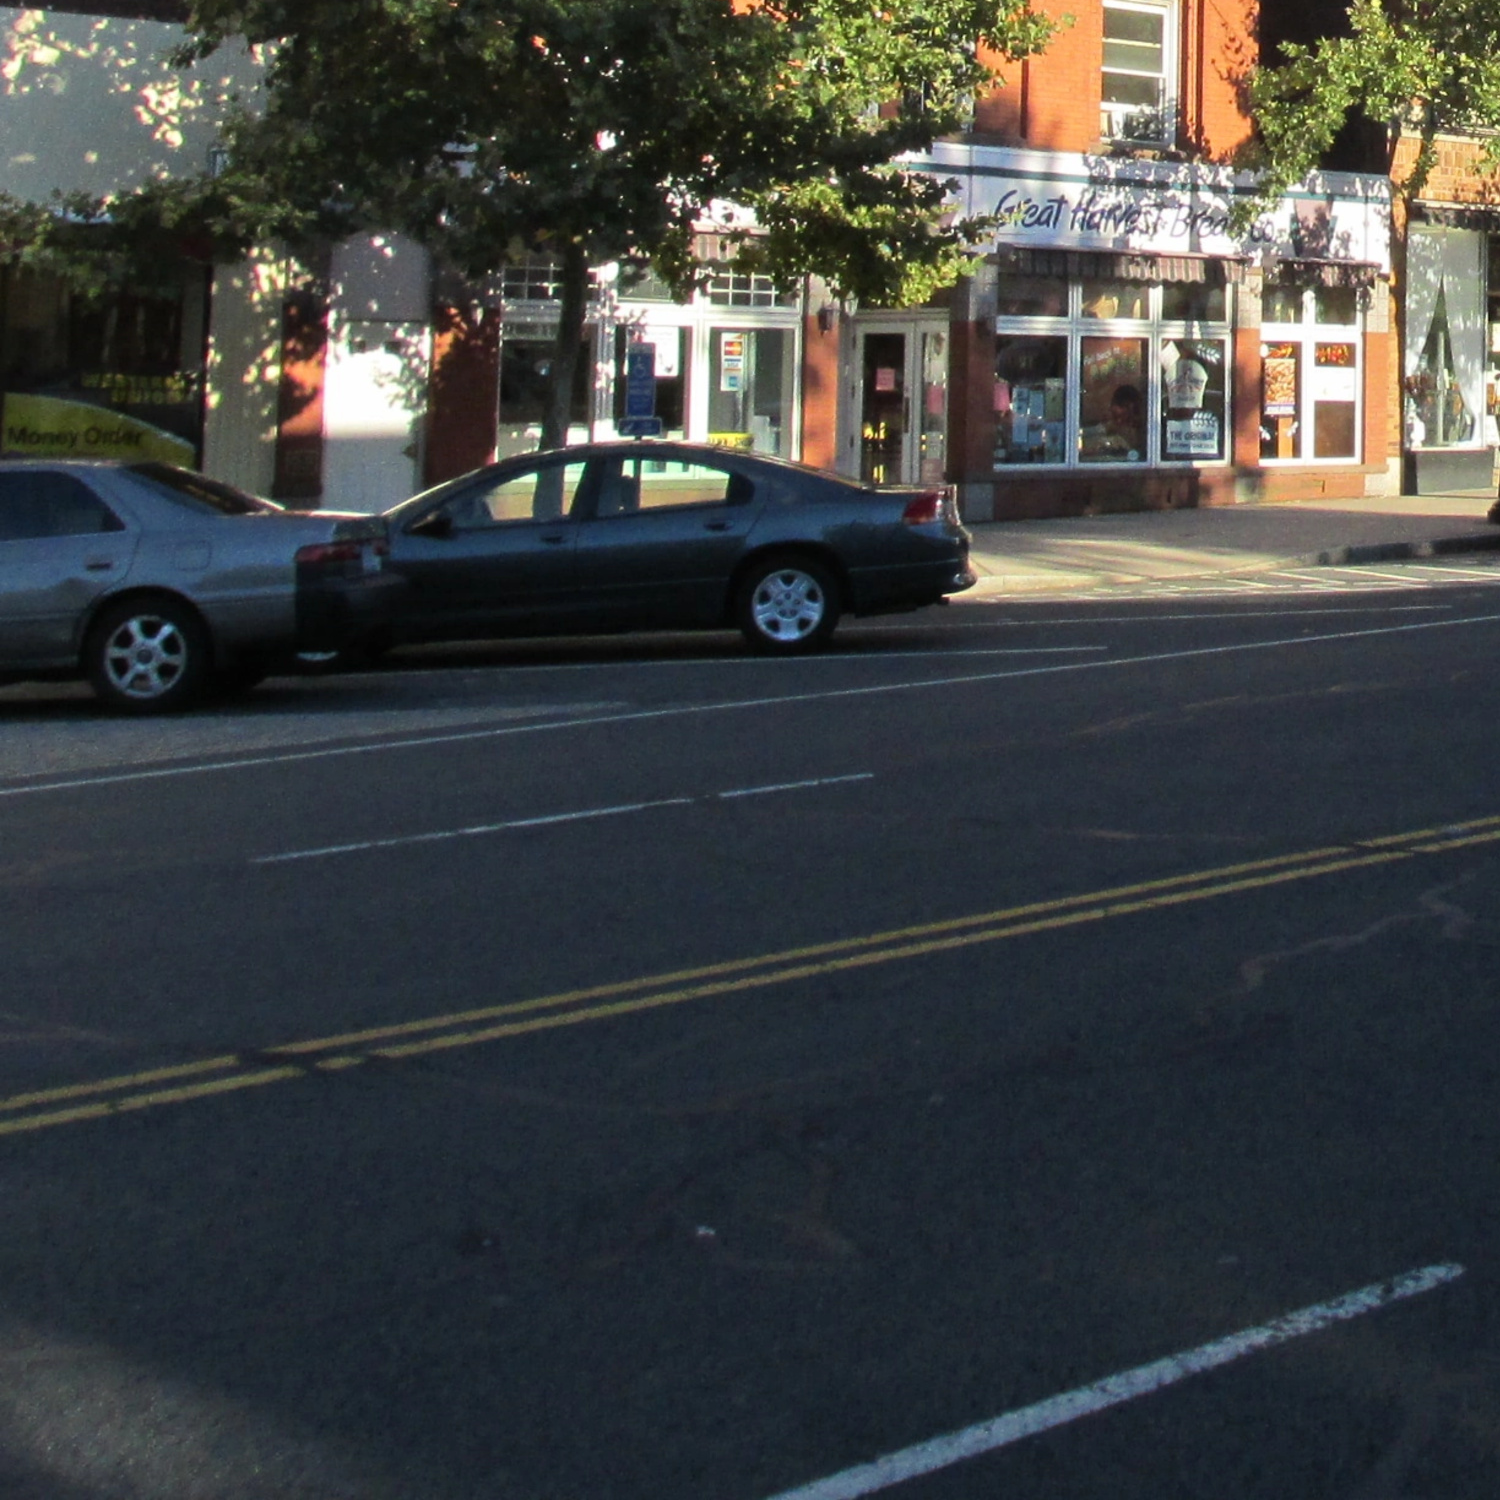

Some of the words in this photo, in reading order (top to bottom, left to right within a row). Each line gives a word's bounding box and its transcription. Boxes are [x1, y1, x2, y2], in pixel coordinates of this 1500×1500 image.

[1170, 204, 1237, 239] Brea
[7, 426, 78, 448] Money
[84, 426, 143, 445] Order
